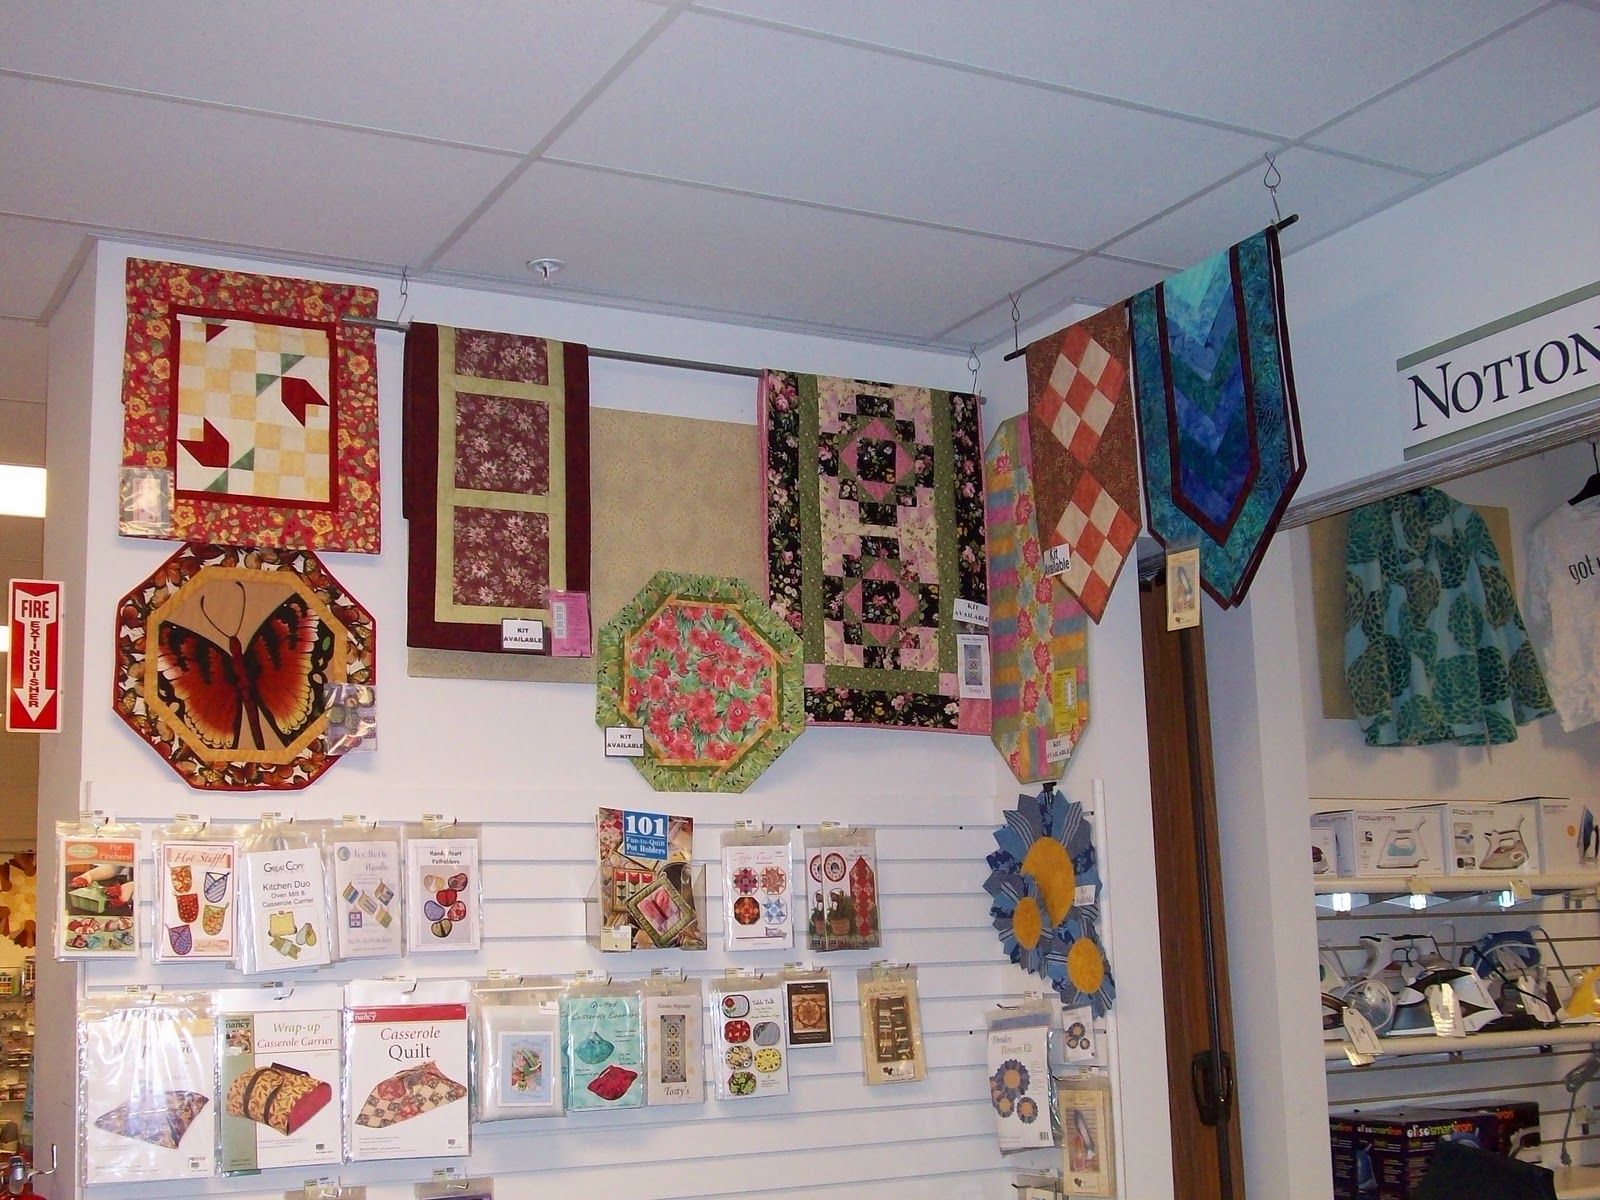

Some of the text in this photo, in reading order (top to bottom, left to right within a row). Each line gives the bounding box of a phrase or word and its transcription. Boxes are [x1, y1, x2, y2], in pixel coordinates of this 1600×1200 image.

[1568, 554, 1595, 585] got
[21, 599, 50, 619] FIRE
[967, 602, 980, 611] KIT
[503, 636, 543, 644] AVAILABLE
[28, 620, 41, 708] EXTINGUISHER
[1053, 740, 1062, 748] KIT
[1047, 748, 1070, 758] AVAILABLE
[625, 815, 666, 837] 101
[625, 836, 666, 847] Fun-to-Quilt
[626, 843, 638, 851] Pot
[640, 845, 666, 855] Holders
[175, 852, 196, 863] Hot
[262, 880, 311, 891] Kitchen Duo
[262, 900, 293, 908] Casserole
[354, 1014, 377, 1022] nancy
[225, 1021, 250, 1029] nancy
[272, 1023, 321, 1035] Wrap-up
[379, 1025, 441, 1041] Casserole
[257, 1036, 334, 1049] Casserole Carrier
[388, 1043, 431, 1062] Quilt
